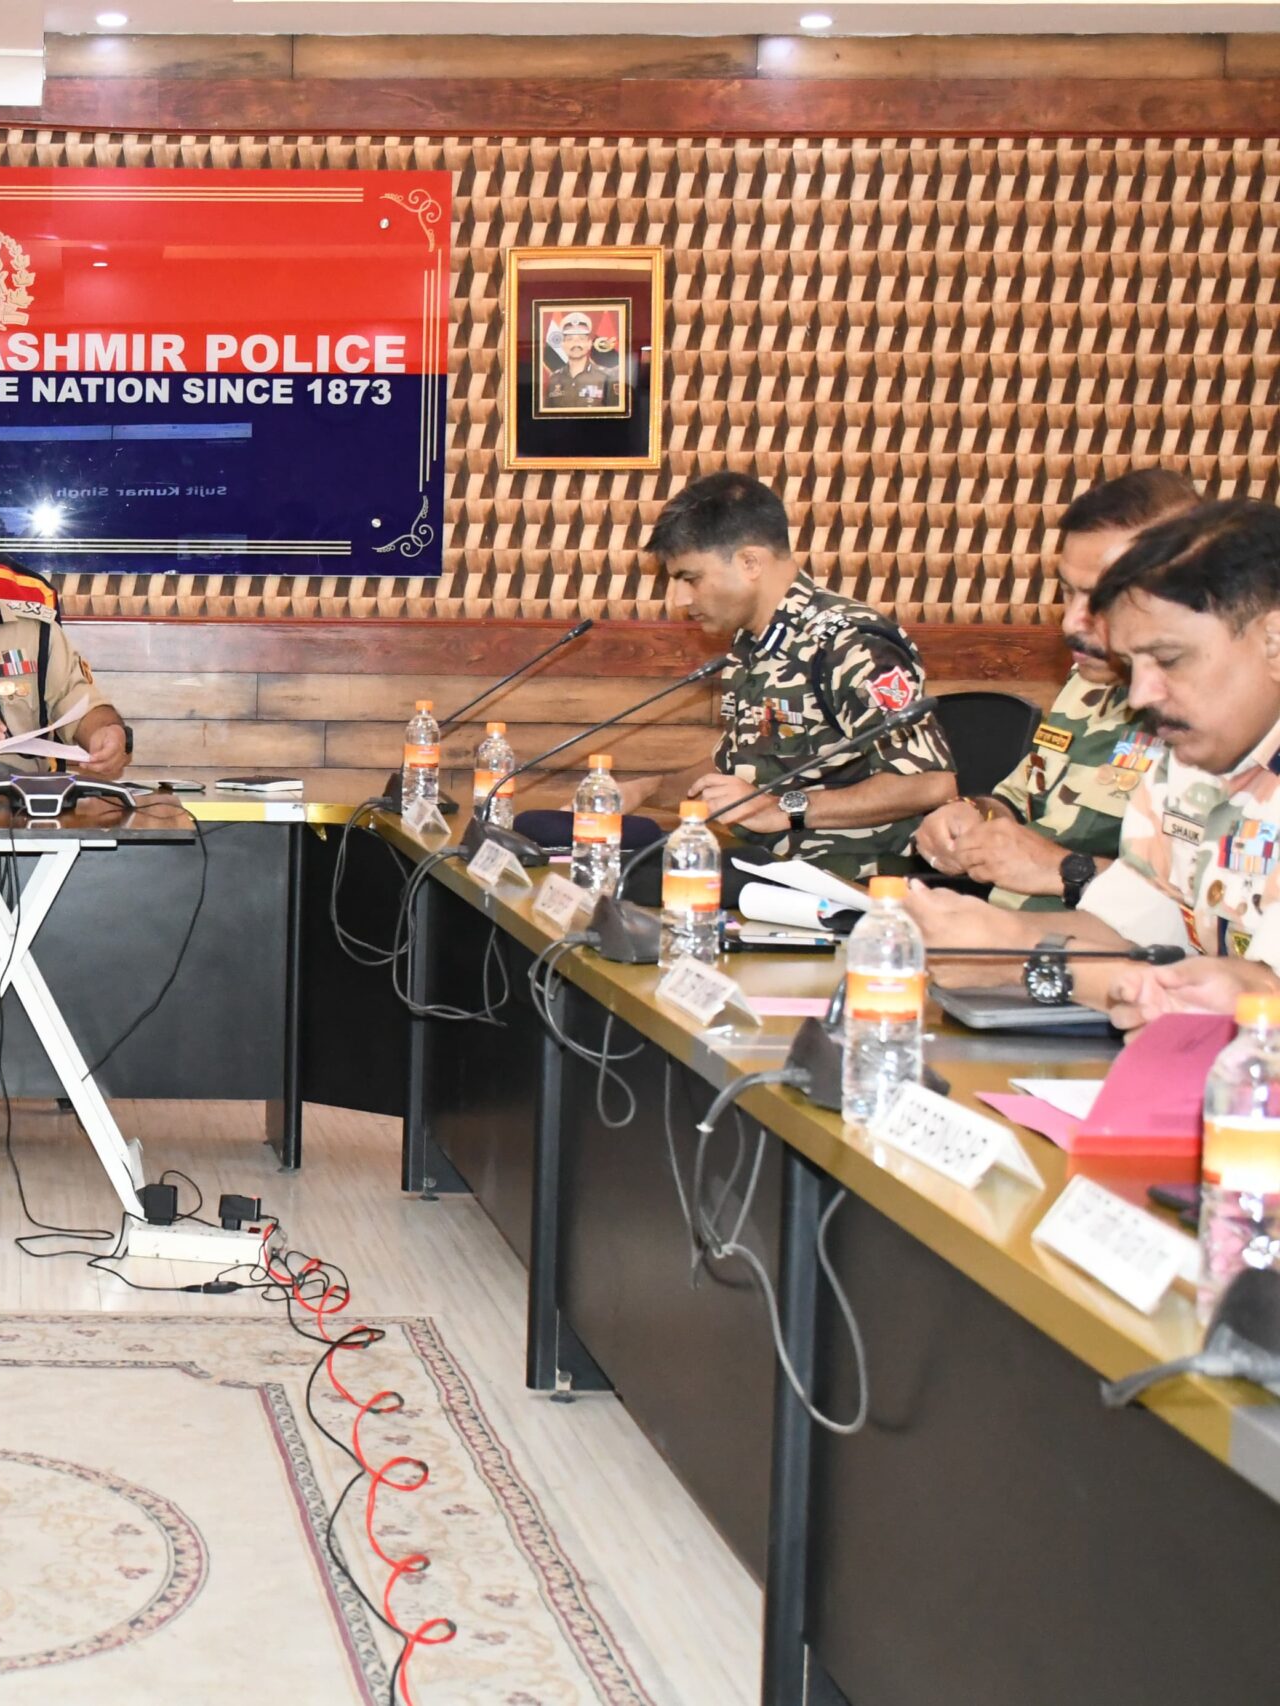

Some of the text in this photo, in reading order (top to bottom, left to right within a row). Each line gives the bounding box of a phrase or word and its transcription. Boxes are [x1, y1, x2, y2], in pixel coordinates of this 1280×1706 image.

[205, 334, 407, 374] POLICE
[32, 377, 170, 403] NATION
[182, 378, 294, 404] SINCE
[307, 379, 392, 405] 1873
